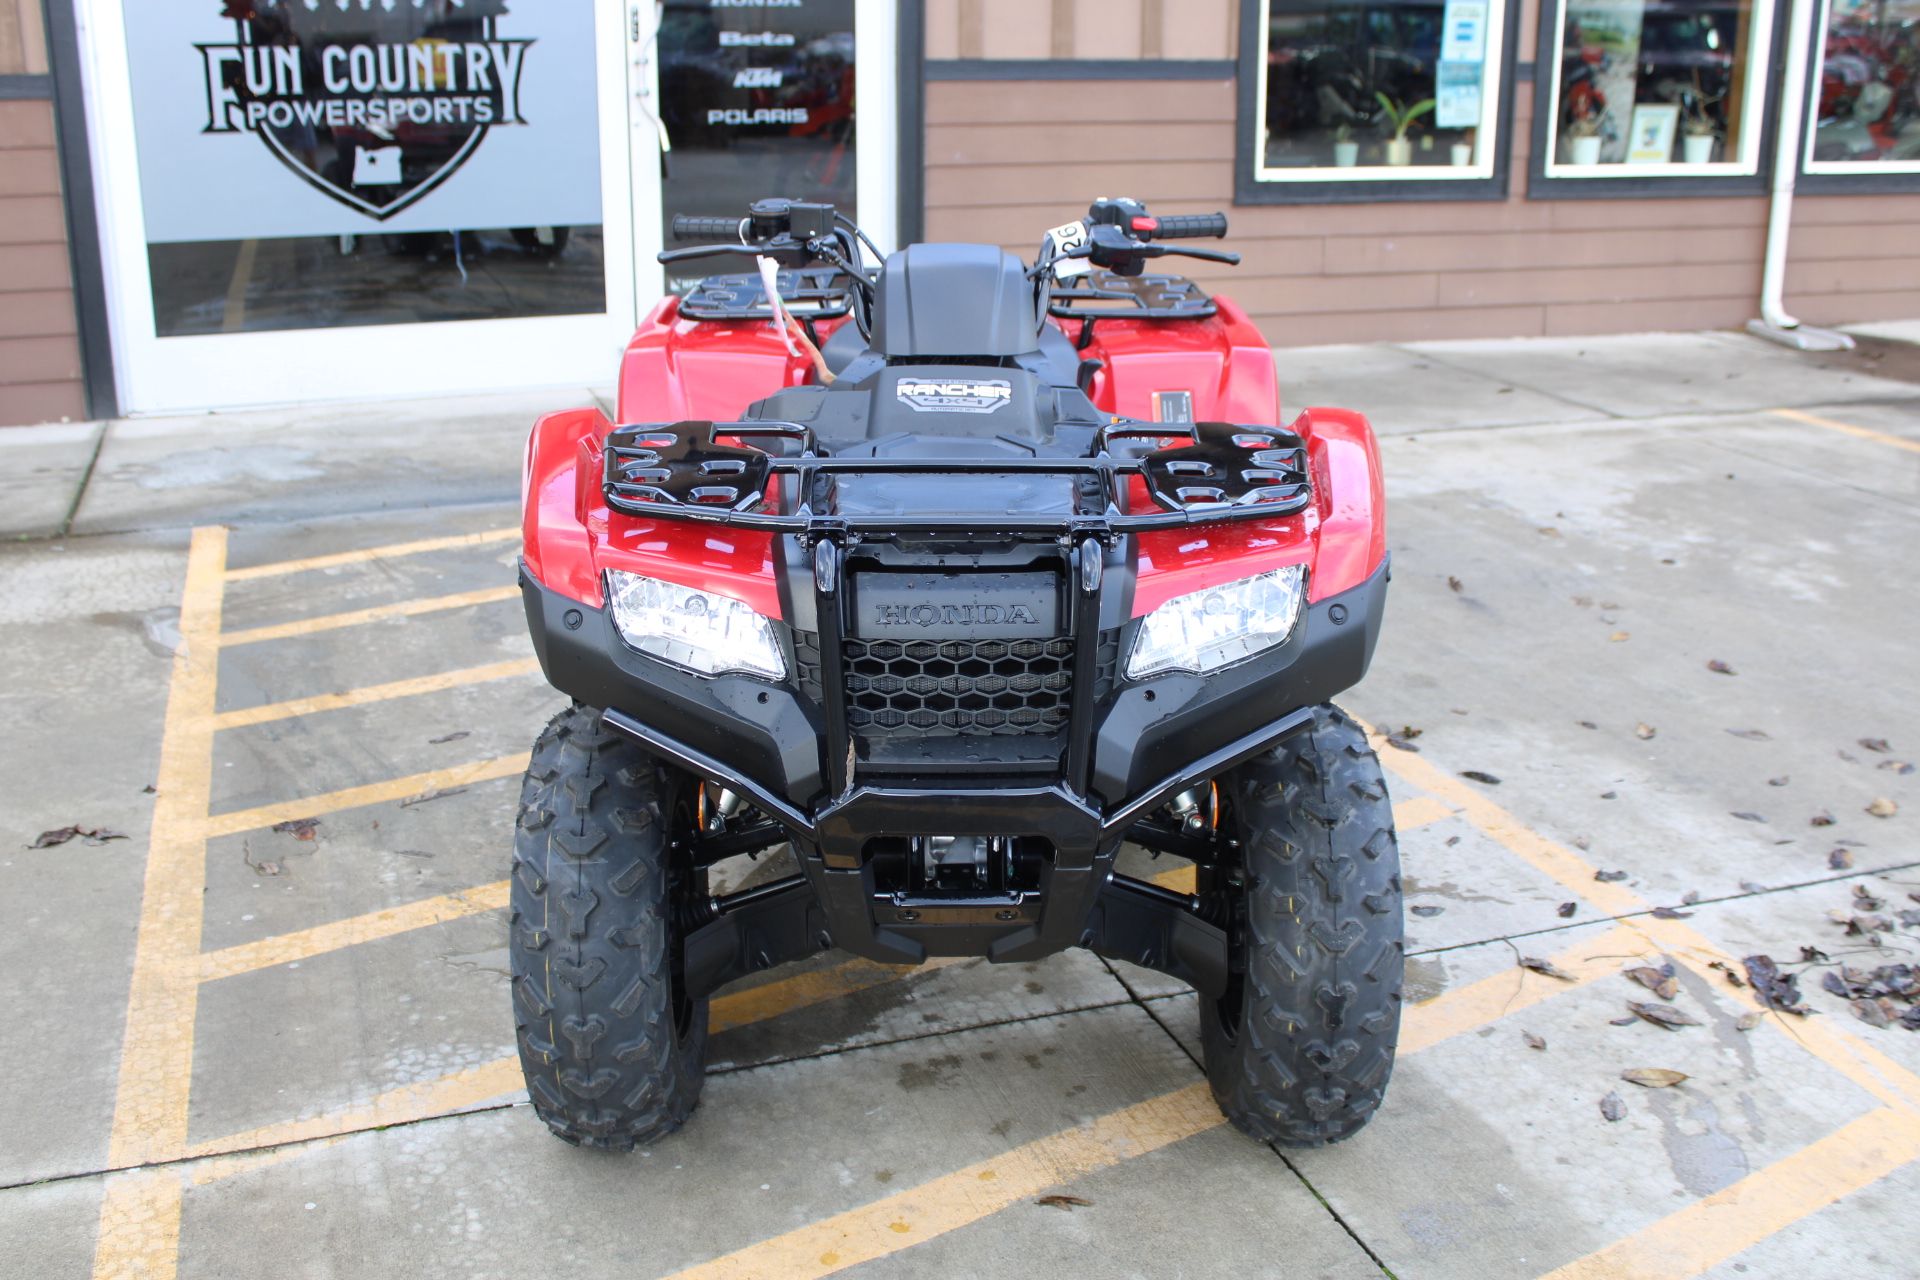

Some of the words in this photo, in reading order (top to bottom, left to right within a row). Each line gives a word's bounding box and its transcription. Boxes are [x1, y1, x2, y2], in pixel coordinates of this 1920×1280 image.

[718, 30, 796, 47] Beta
[202, 44, 303, 131] FUN
[322, 42, 525, 122] COUNTRY
[733, 67, 783, 88] KTM
[248, 96, 494, 128] POWERSPORTS
[707, 107, 809, 125] POLARIS
[897, 383, 1012, 400] RANCHER
[875, 604, 1041, 627] HONDA
